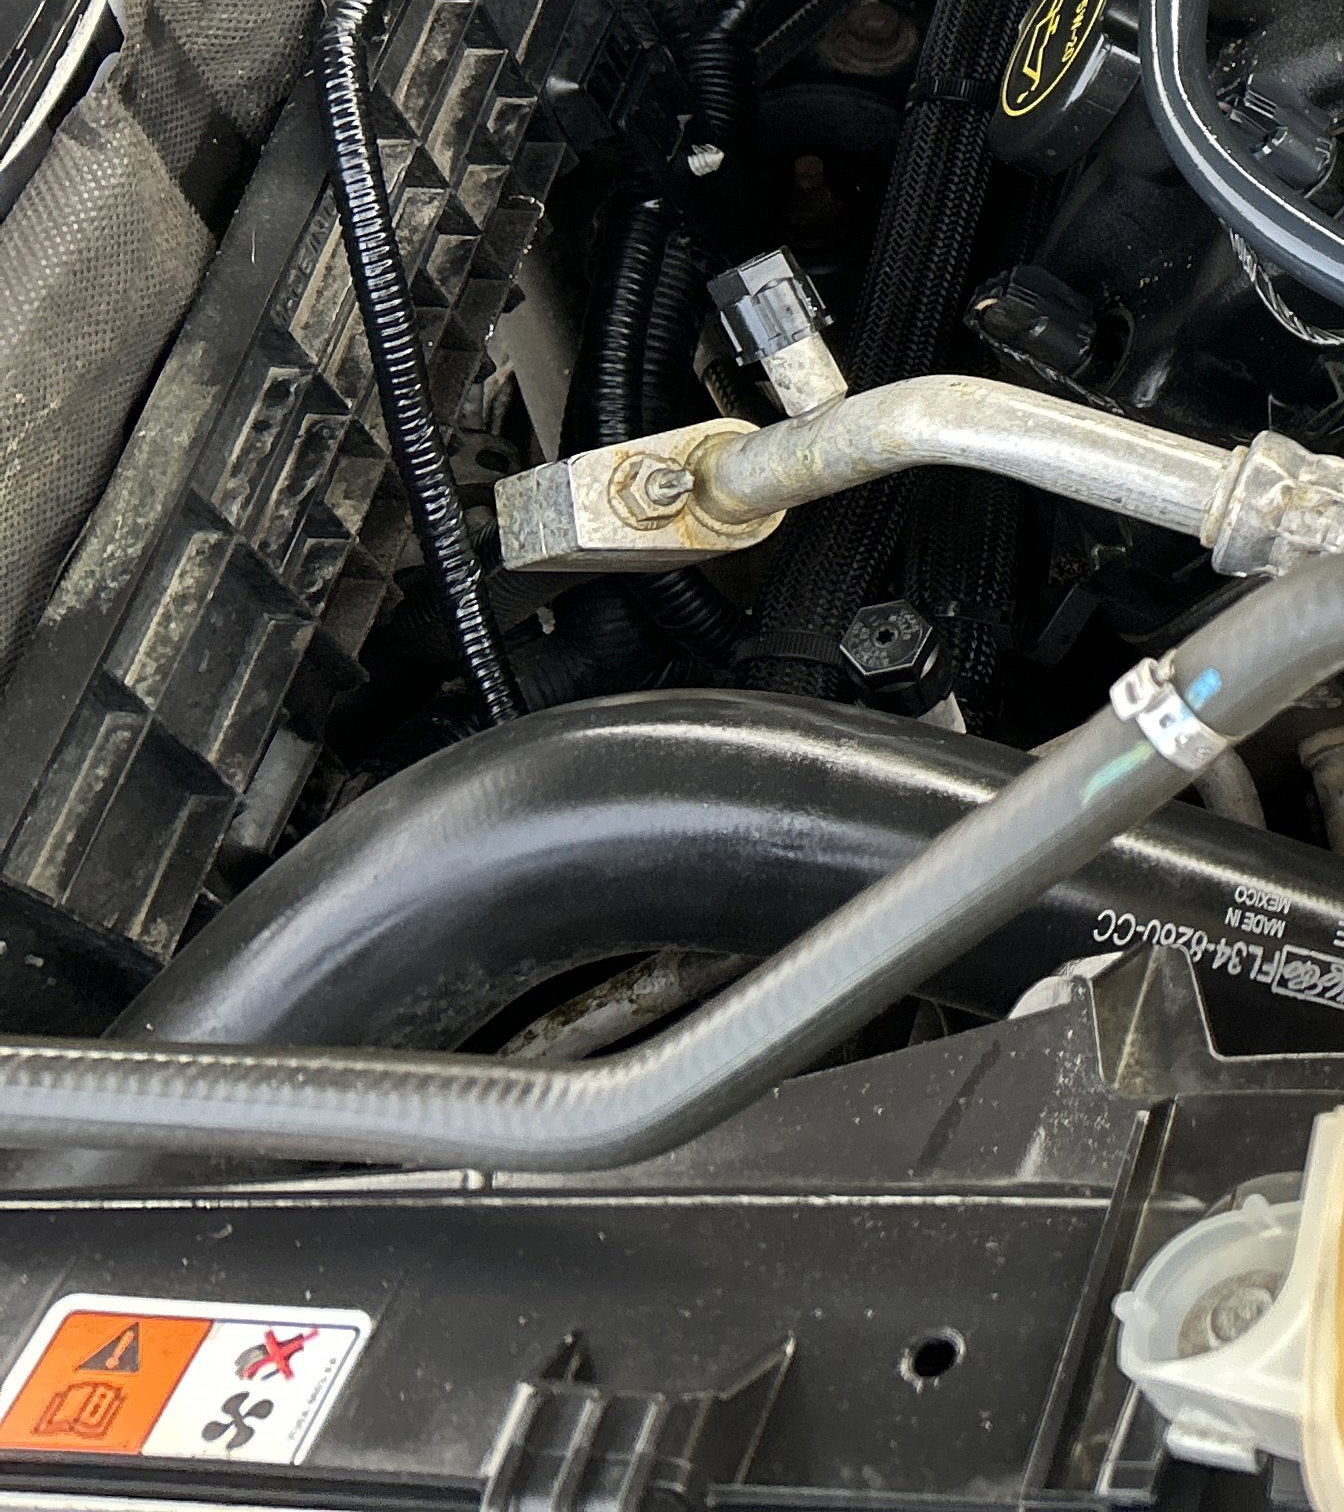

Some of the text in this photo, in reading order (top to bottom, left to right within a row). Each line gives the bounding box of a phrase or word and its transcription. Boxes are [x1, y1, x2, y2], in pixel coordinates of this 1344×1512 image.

[1234, 885, 1291, 915] MEXICO
[1225, 907, 1286, 939] MADE IN
